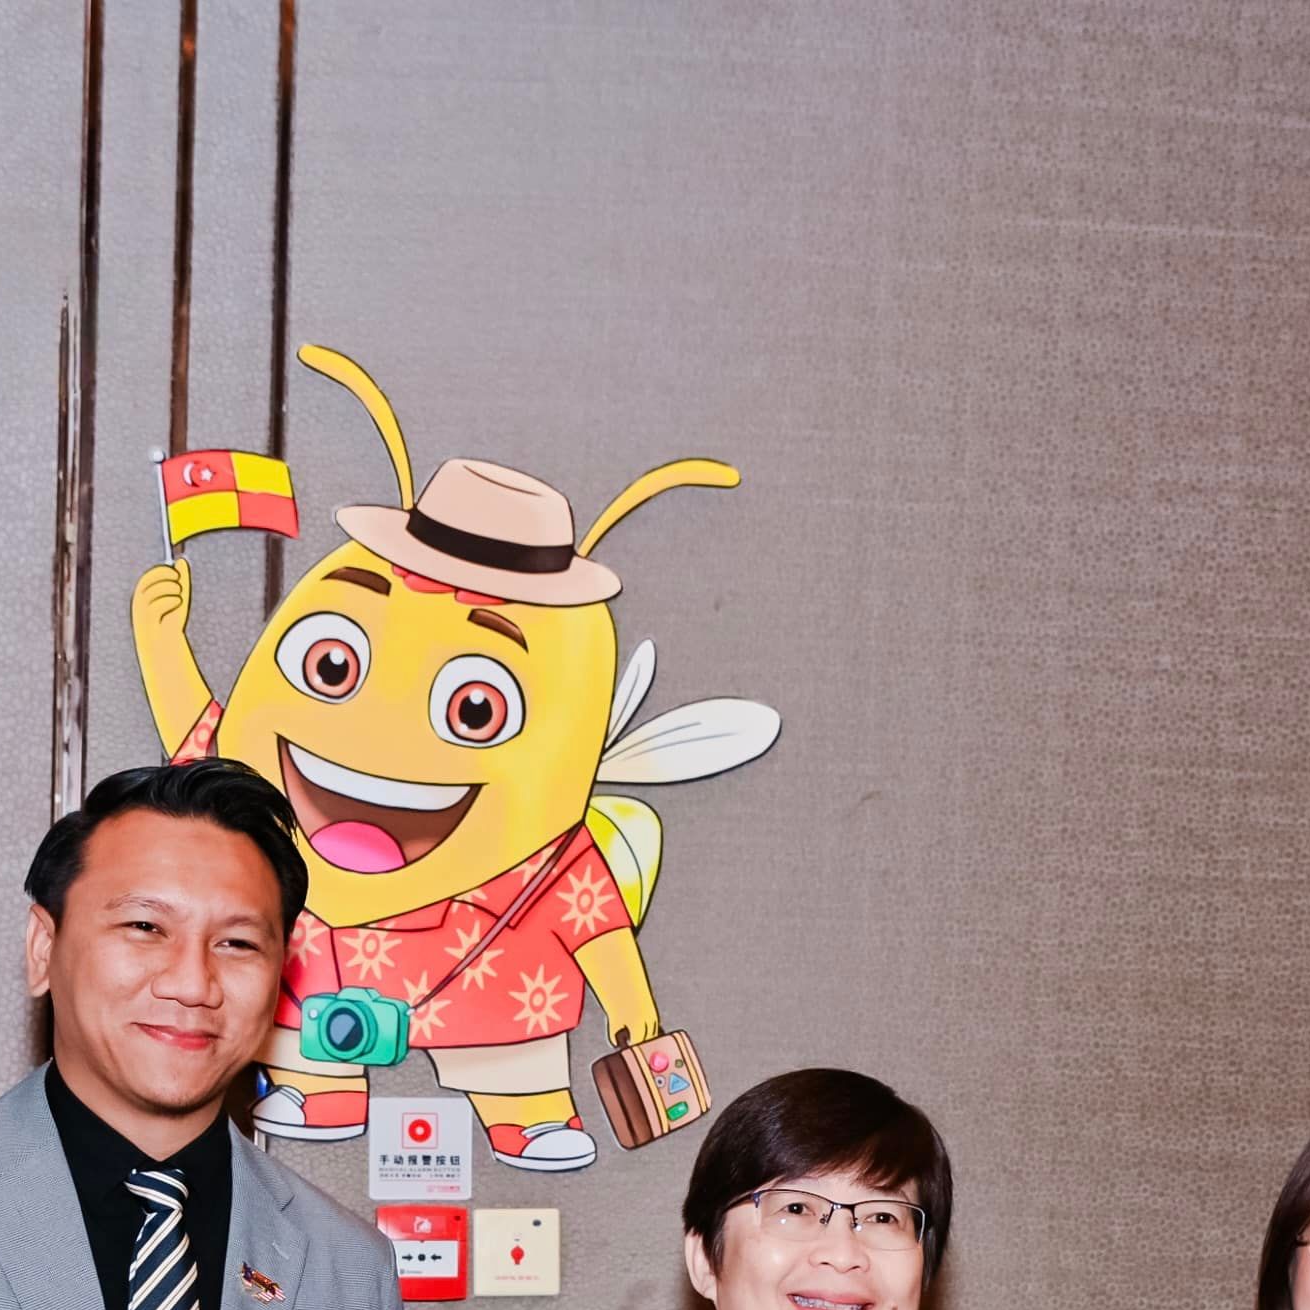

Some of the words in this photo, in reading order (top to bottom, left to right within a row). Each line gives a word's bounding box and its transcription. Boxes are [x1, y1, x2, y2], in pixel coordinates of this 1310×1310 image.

[379, 1154, 460, 1166] 手动报警按钮
